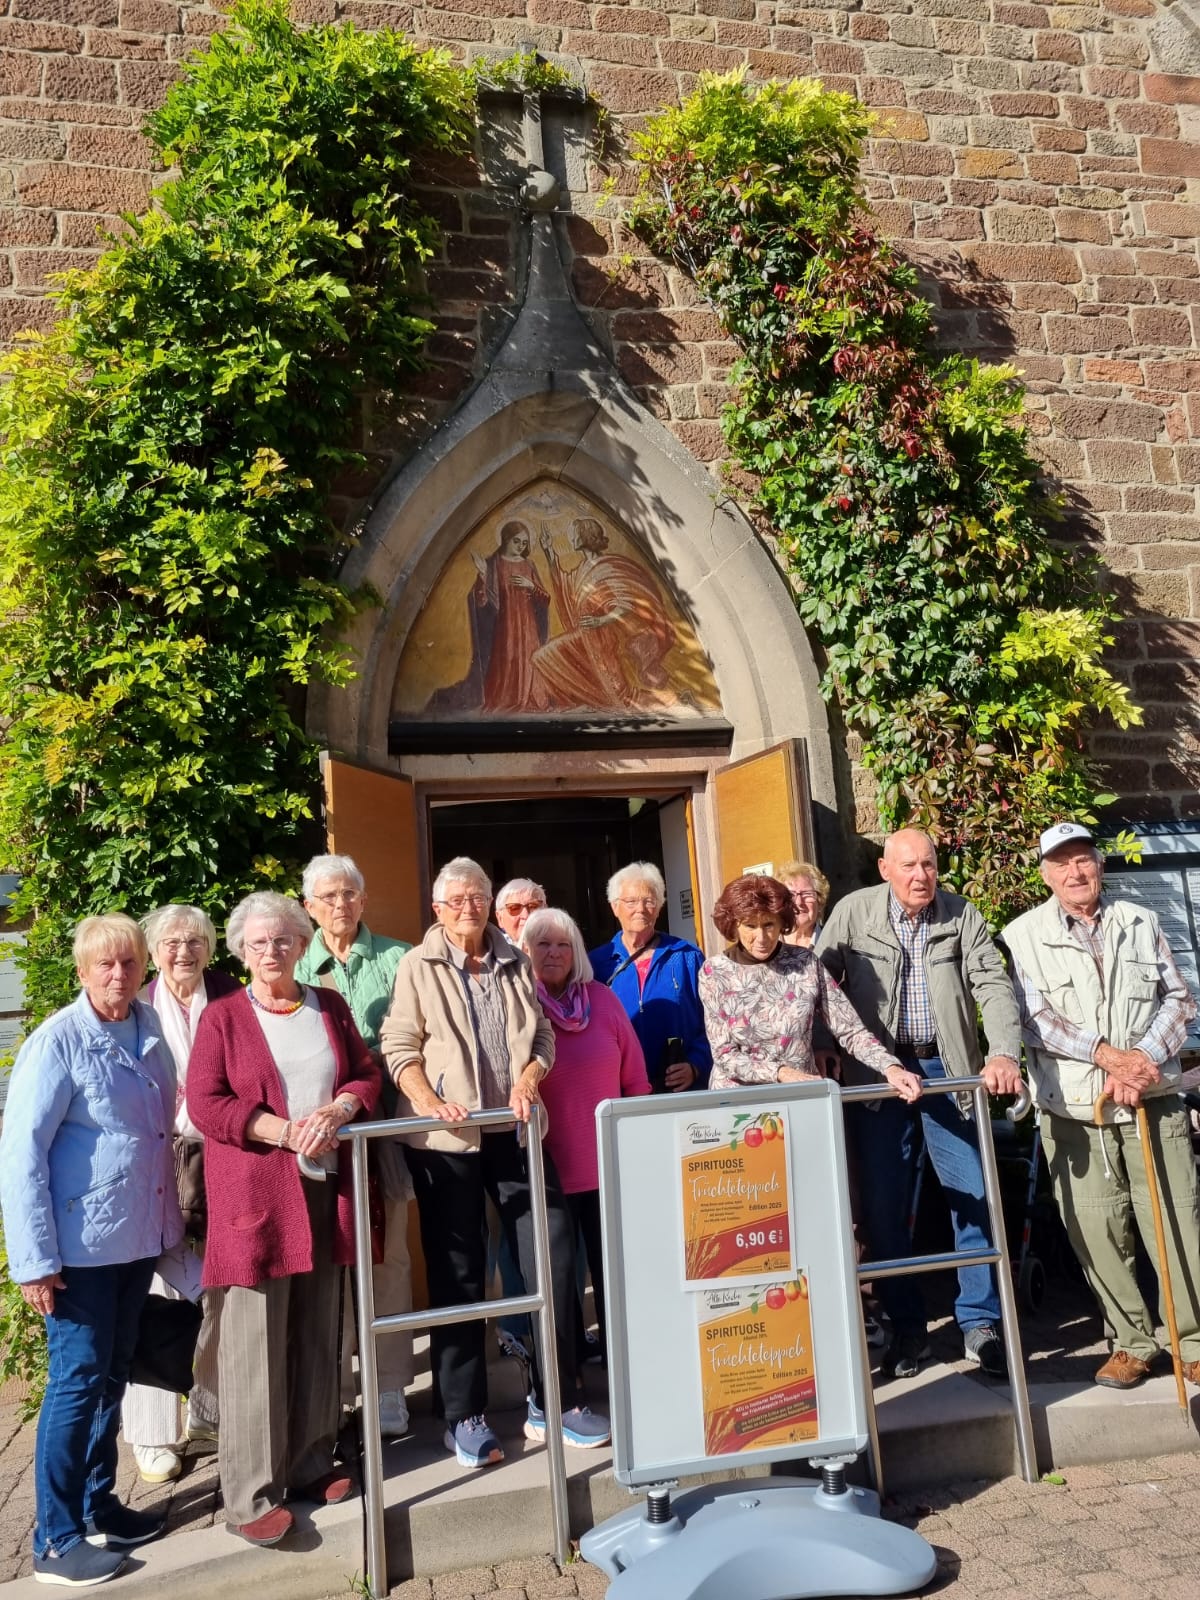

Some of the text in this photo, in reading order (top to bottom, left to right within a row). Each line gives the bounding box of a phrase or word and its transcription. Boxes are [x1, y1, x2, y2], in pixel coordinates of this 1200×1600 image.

[688, 1158, 744, 1172] SPIRITUOSE
[748, 1203, 768, 1211] Edition
[769, 1201, 782, 1209] 2025
[736, 1230, 777, 1249] 6,90 €
[706, 1322, 766, 1340] SPIRITUOSE
[772, 1370, 793, 1379] Edition
